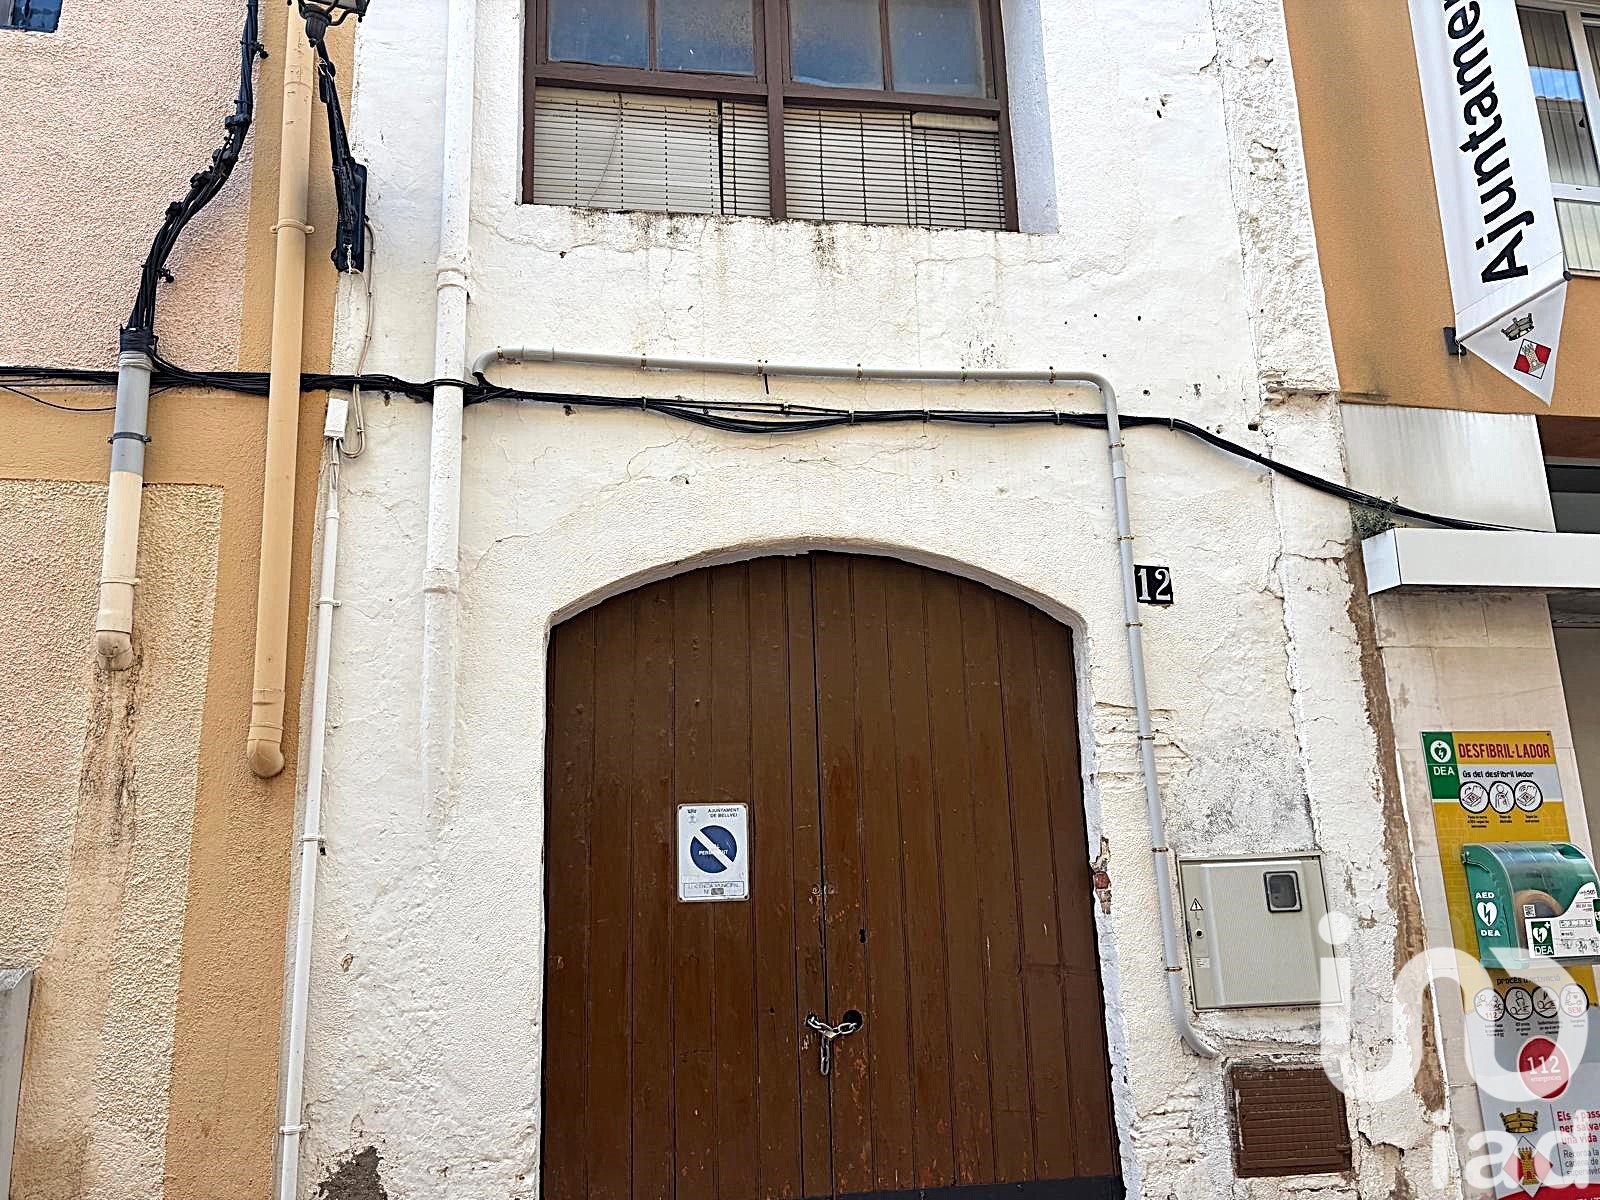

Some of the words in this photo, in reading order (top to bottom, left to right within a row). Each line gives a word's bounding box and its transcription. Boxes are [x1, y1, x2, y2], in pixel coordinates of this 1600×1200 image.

[1137, 568, 1171, 601] 12
[1433, 766, 1455, 776] DEA
[1481, 929, 1501, 937] DEA
[1534, 945, 1554, 955] DEA
[1527, 1056, 1561, 1075] 112
[1556, 1110, 1572, 1122] Els
